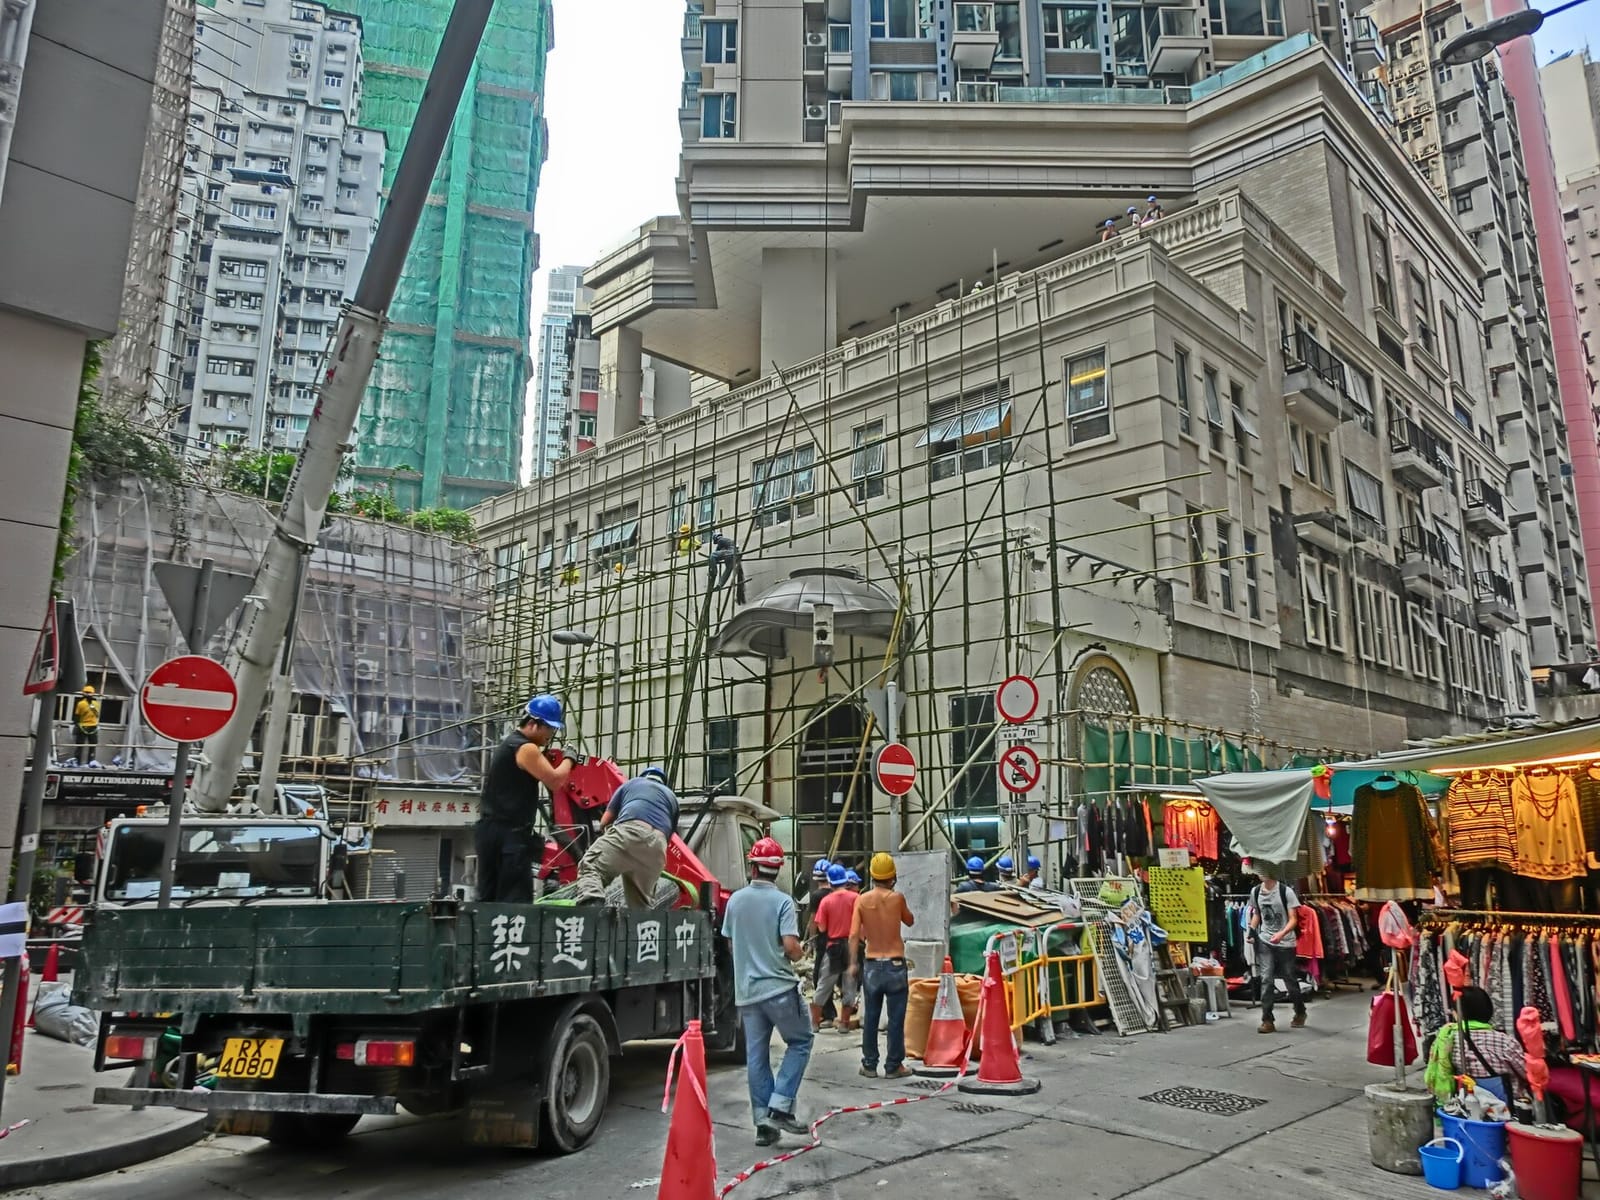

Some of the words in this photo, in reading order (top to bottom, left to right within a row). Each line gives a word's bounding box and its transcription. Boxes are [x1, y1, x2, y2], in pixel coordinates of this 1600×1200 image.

[141, 778, 165, 786] STORE
[238, 1039, 267, 1057] RX
[220, 1056, 274, 1076] 4080
